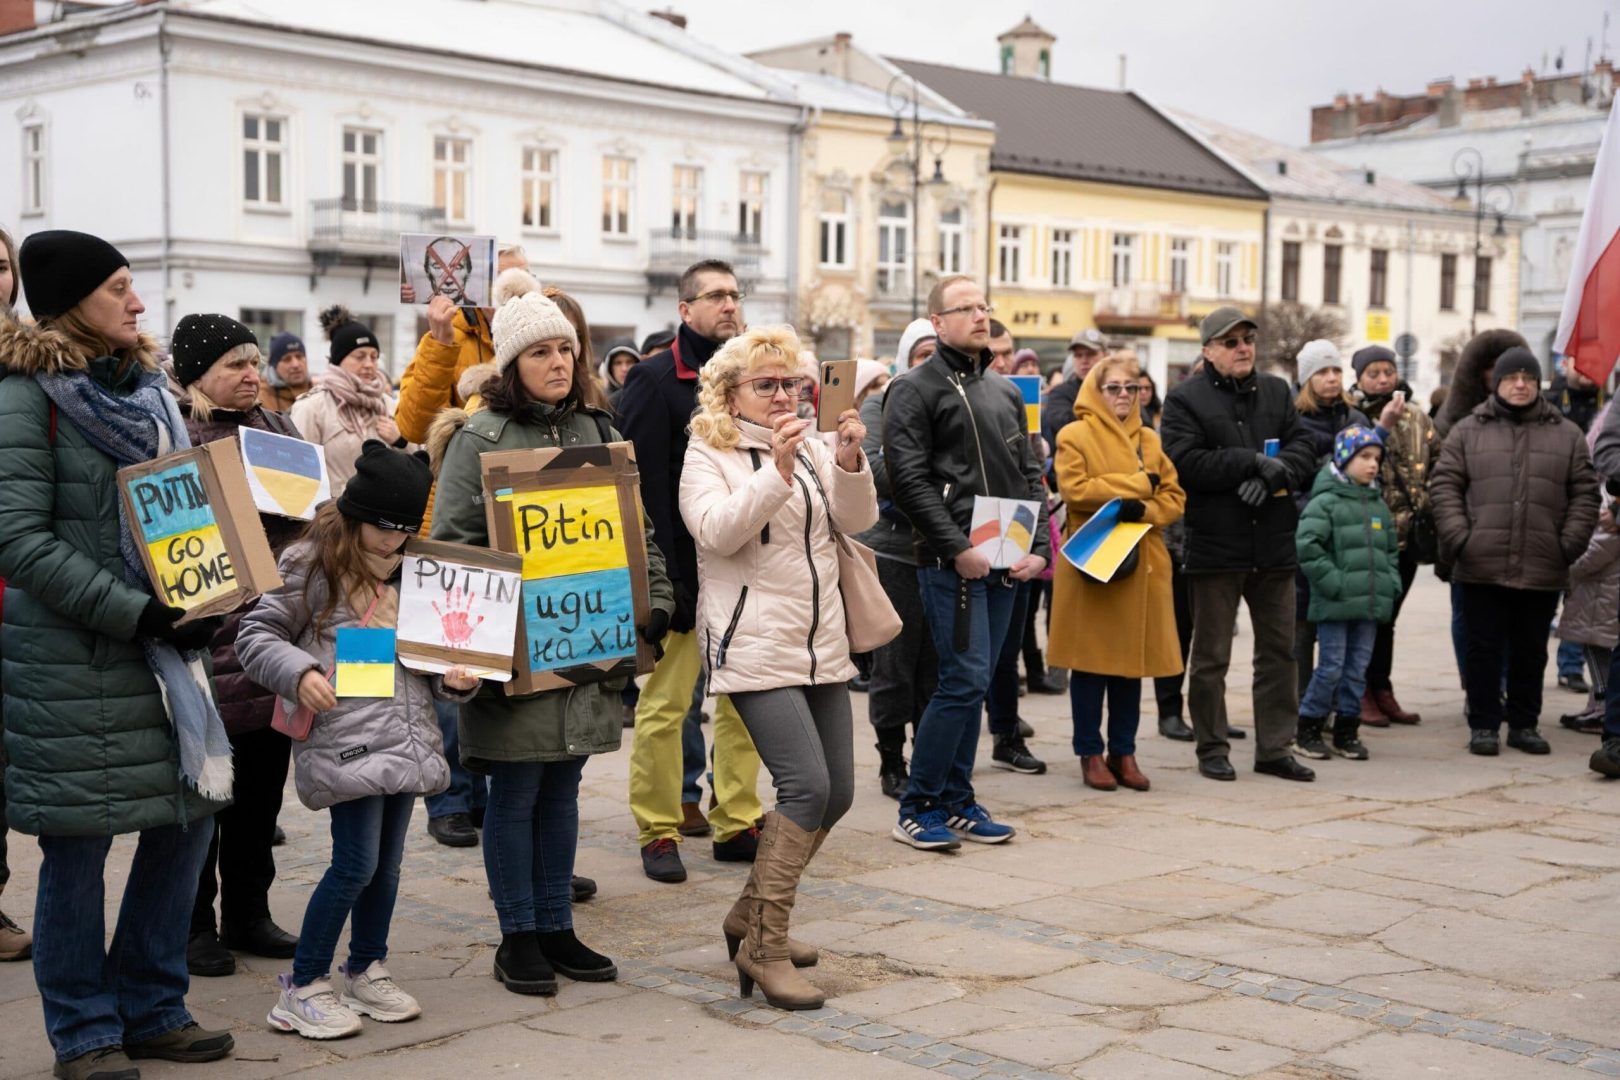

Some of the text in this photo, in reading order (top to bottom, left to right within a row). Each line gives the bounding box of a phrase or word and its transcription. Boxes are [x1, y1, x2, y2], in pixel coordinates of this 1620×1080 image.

[167, 535, 205, 565] GO
[517, 502, 615, 554] Putin
[160, 552, 236, 604] HOME
[414, 556, 521, 605] PUTIN
